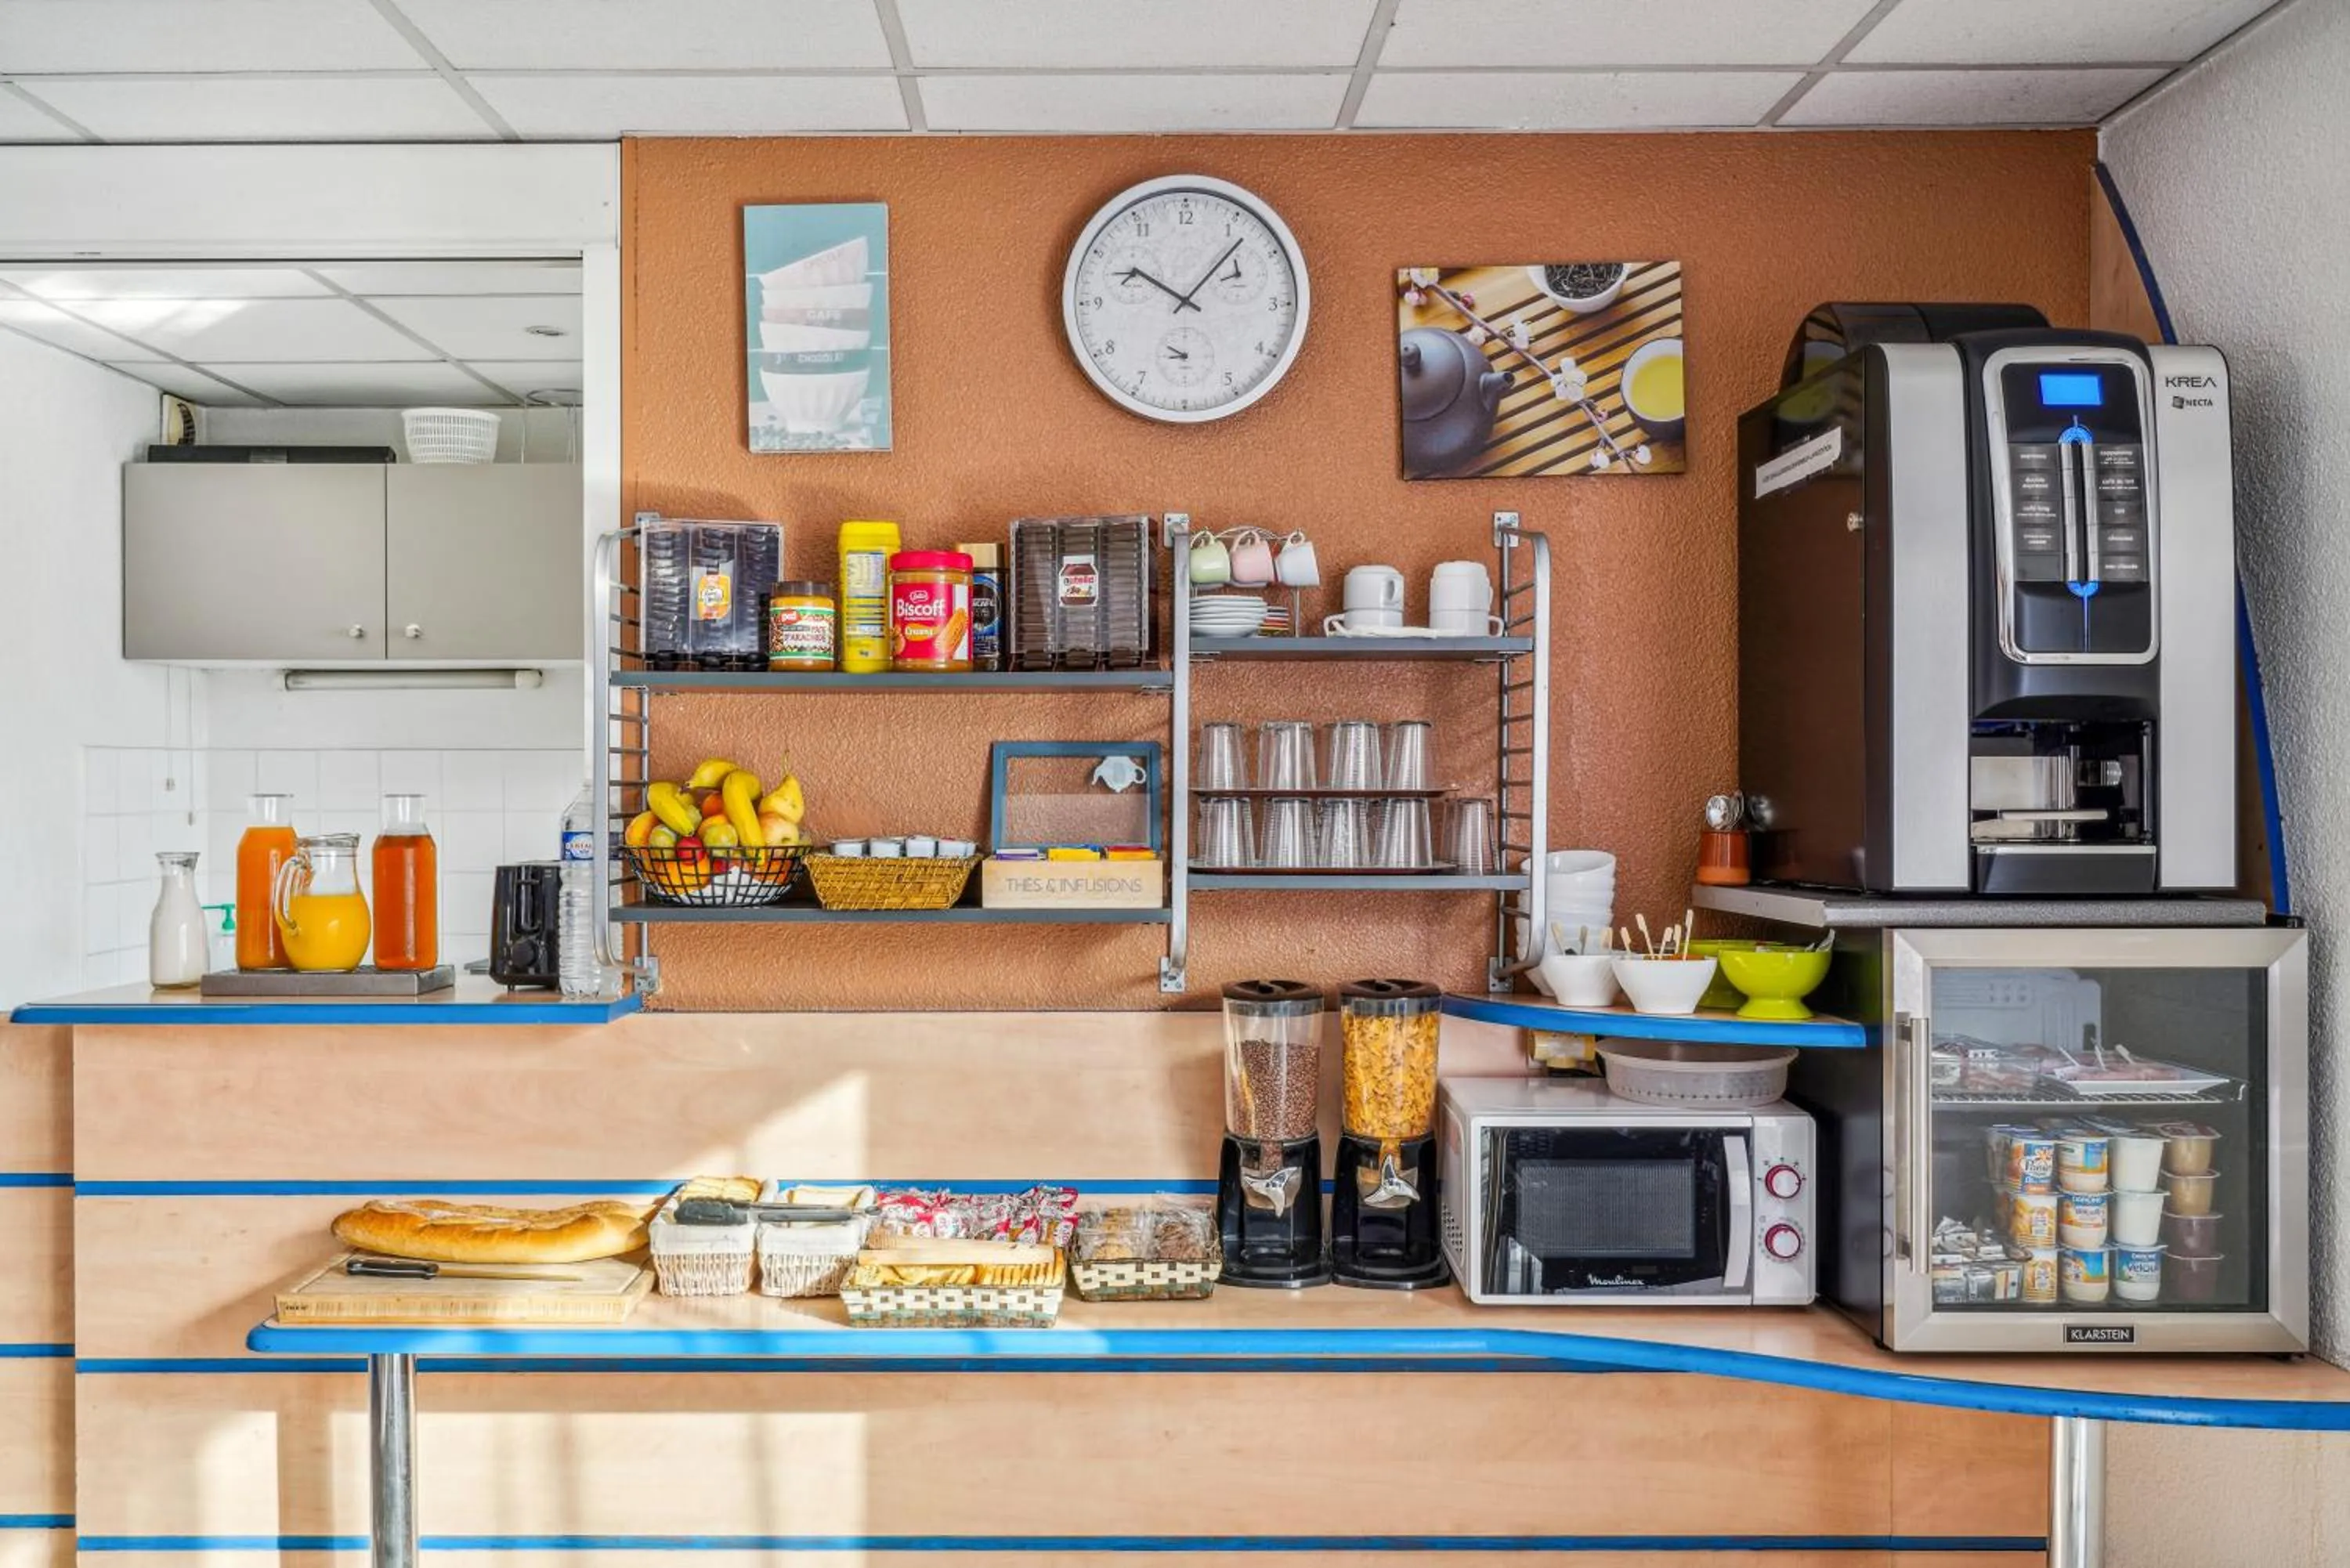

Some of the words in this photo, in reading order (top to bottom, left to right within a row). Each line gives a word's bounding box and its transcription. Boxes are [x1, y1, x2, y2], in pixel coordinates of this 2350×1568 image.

[1178, 211, 1193, 225] 12
[1137, 223, 1149, 237] 11
[1224, 223, 1231, 237] 1
[1094, 297, 1103, 311] 9
[1267, 298, 1278, 312] 3
[1105, 340, 1115, 354] 8
[1255, 341, 1264, 354] 4
[1138, 371, 1147, 385] 7
[1224, 372, 1232, 386] 5
[2164, 376, 2218, 388] KREA
[2185, 398, 2214, 407] NECTA
[896, 598, 946, 617] Biscoff
[1046, 878, 1056, 893] &
[1059, 877, 1143, 892] INFUSIONS
[1587, 1273, 1645, 1285] Moulinex
[2070, 1329, 2130, 1340] KLARSTEIN
